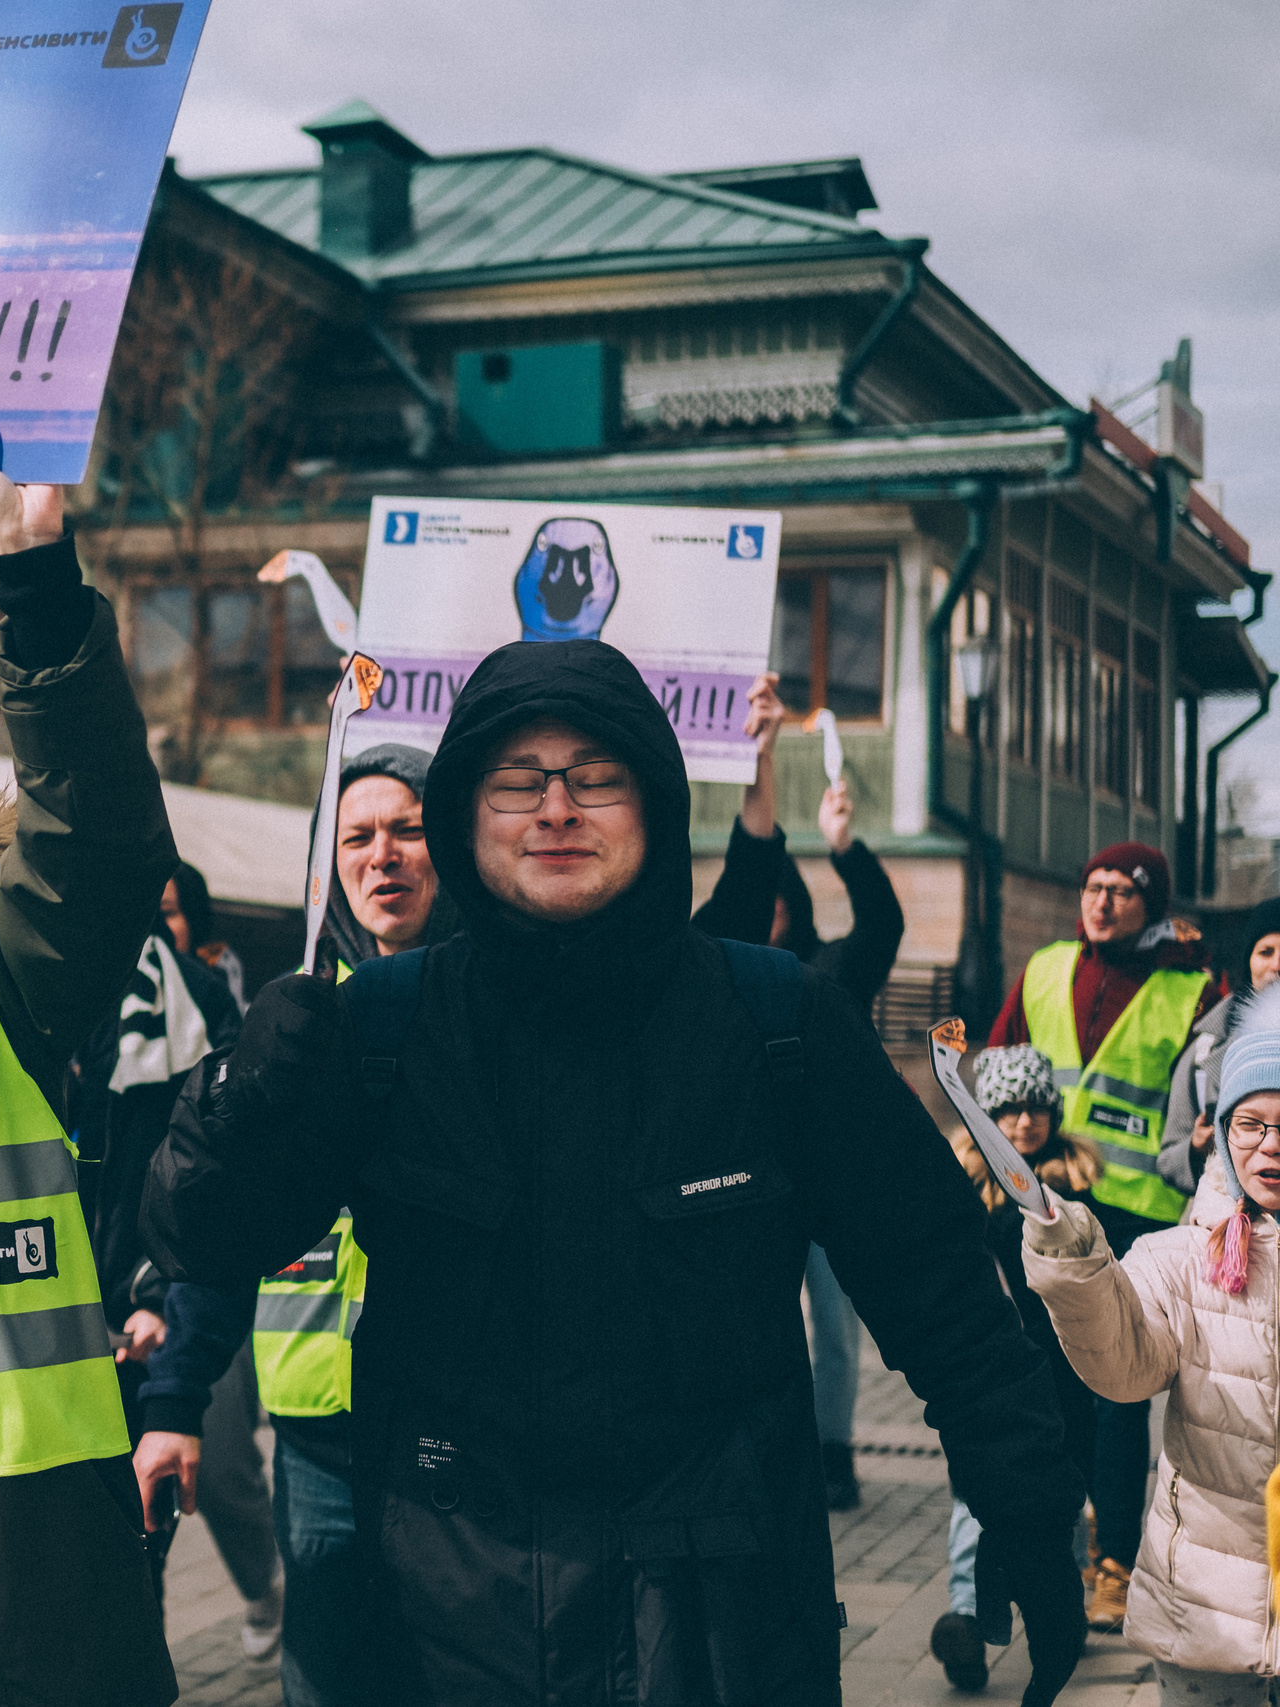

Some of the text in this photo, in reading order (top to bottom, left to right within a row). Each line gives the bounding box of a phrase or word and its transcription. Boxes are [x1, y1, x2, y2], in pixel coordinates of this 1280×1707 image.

[659, 677, 735, 730] Й!!!
[681, 1172, 752, 1196] SUPERIOR RAPID+
